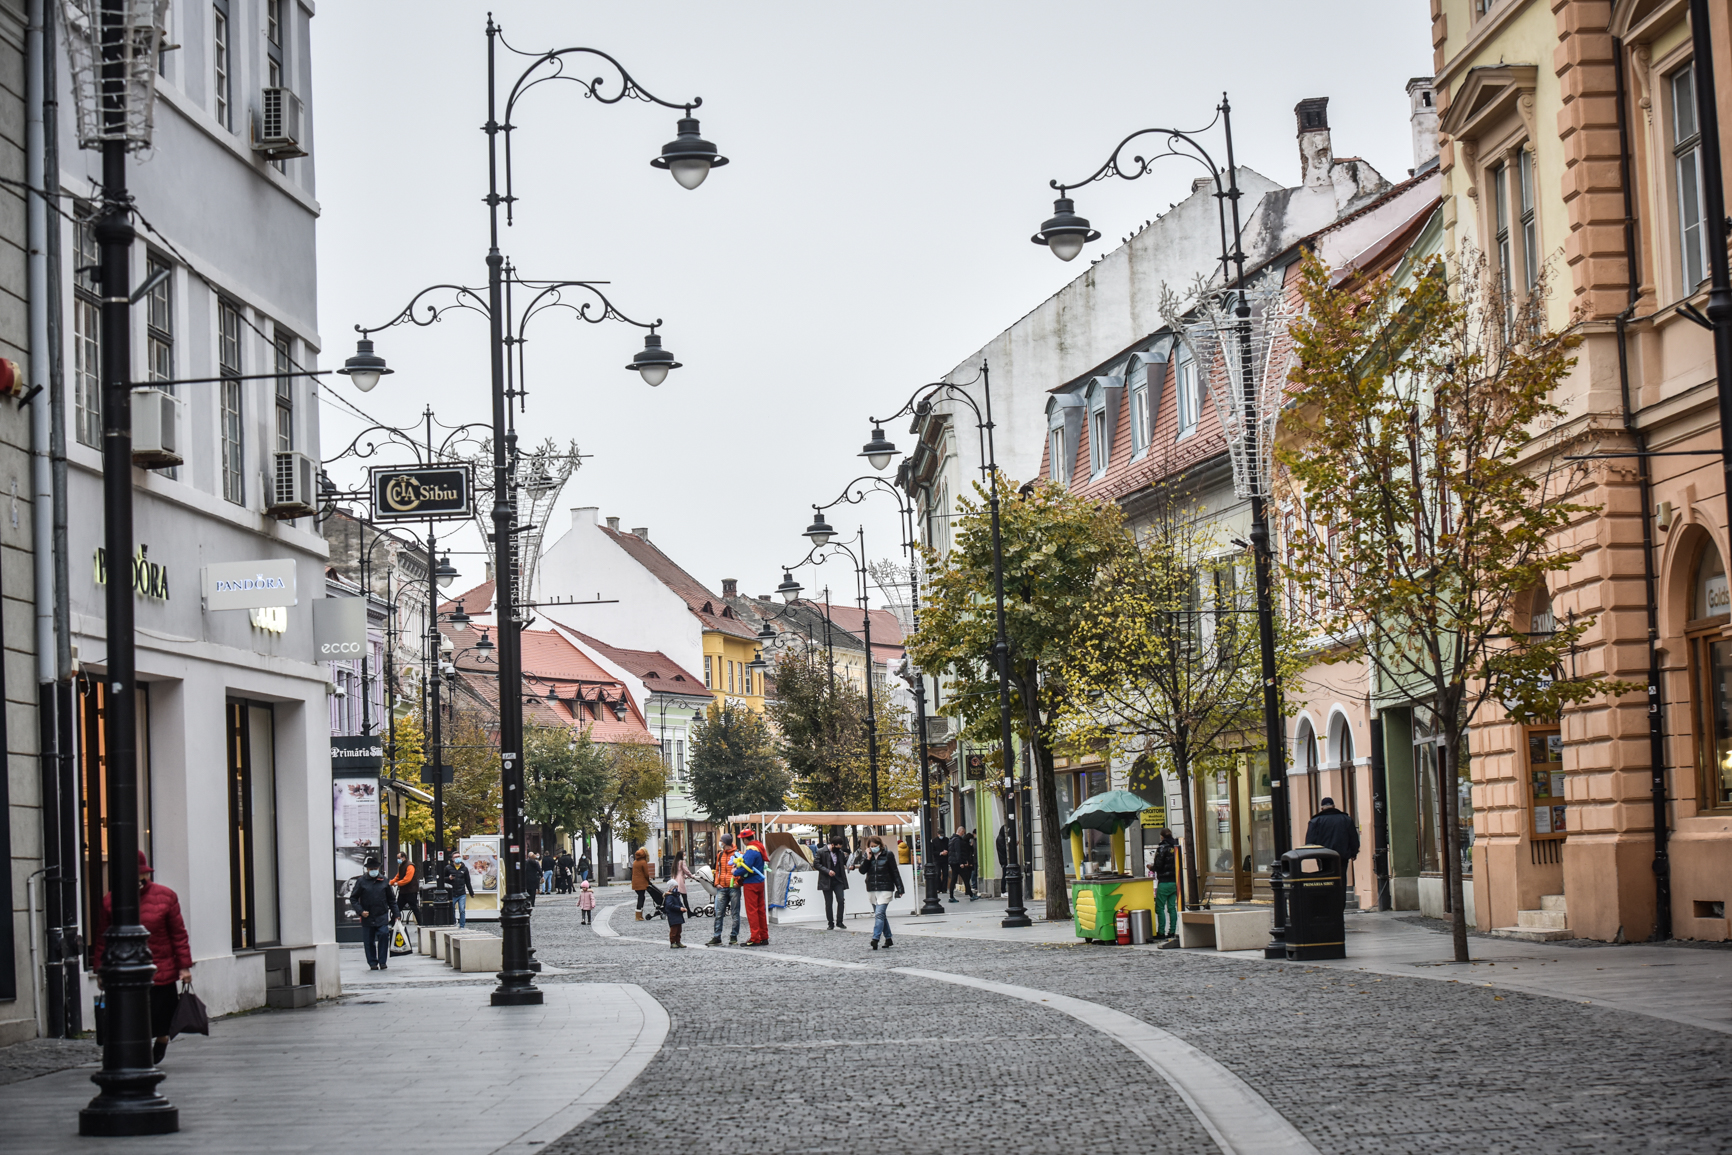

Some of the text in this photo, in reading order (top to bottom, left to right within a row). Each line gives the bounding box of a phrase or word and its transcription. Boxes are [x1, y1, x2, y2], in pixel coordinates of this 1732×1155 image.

[420, 484, 458, 501] Sibiu
[95, 546, 169, 600] PDORA
[216, 575, 285, 592] PANDORA
[321, 641, 360, 655] ecco
